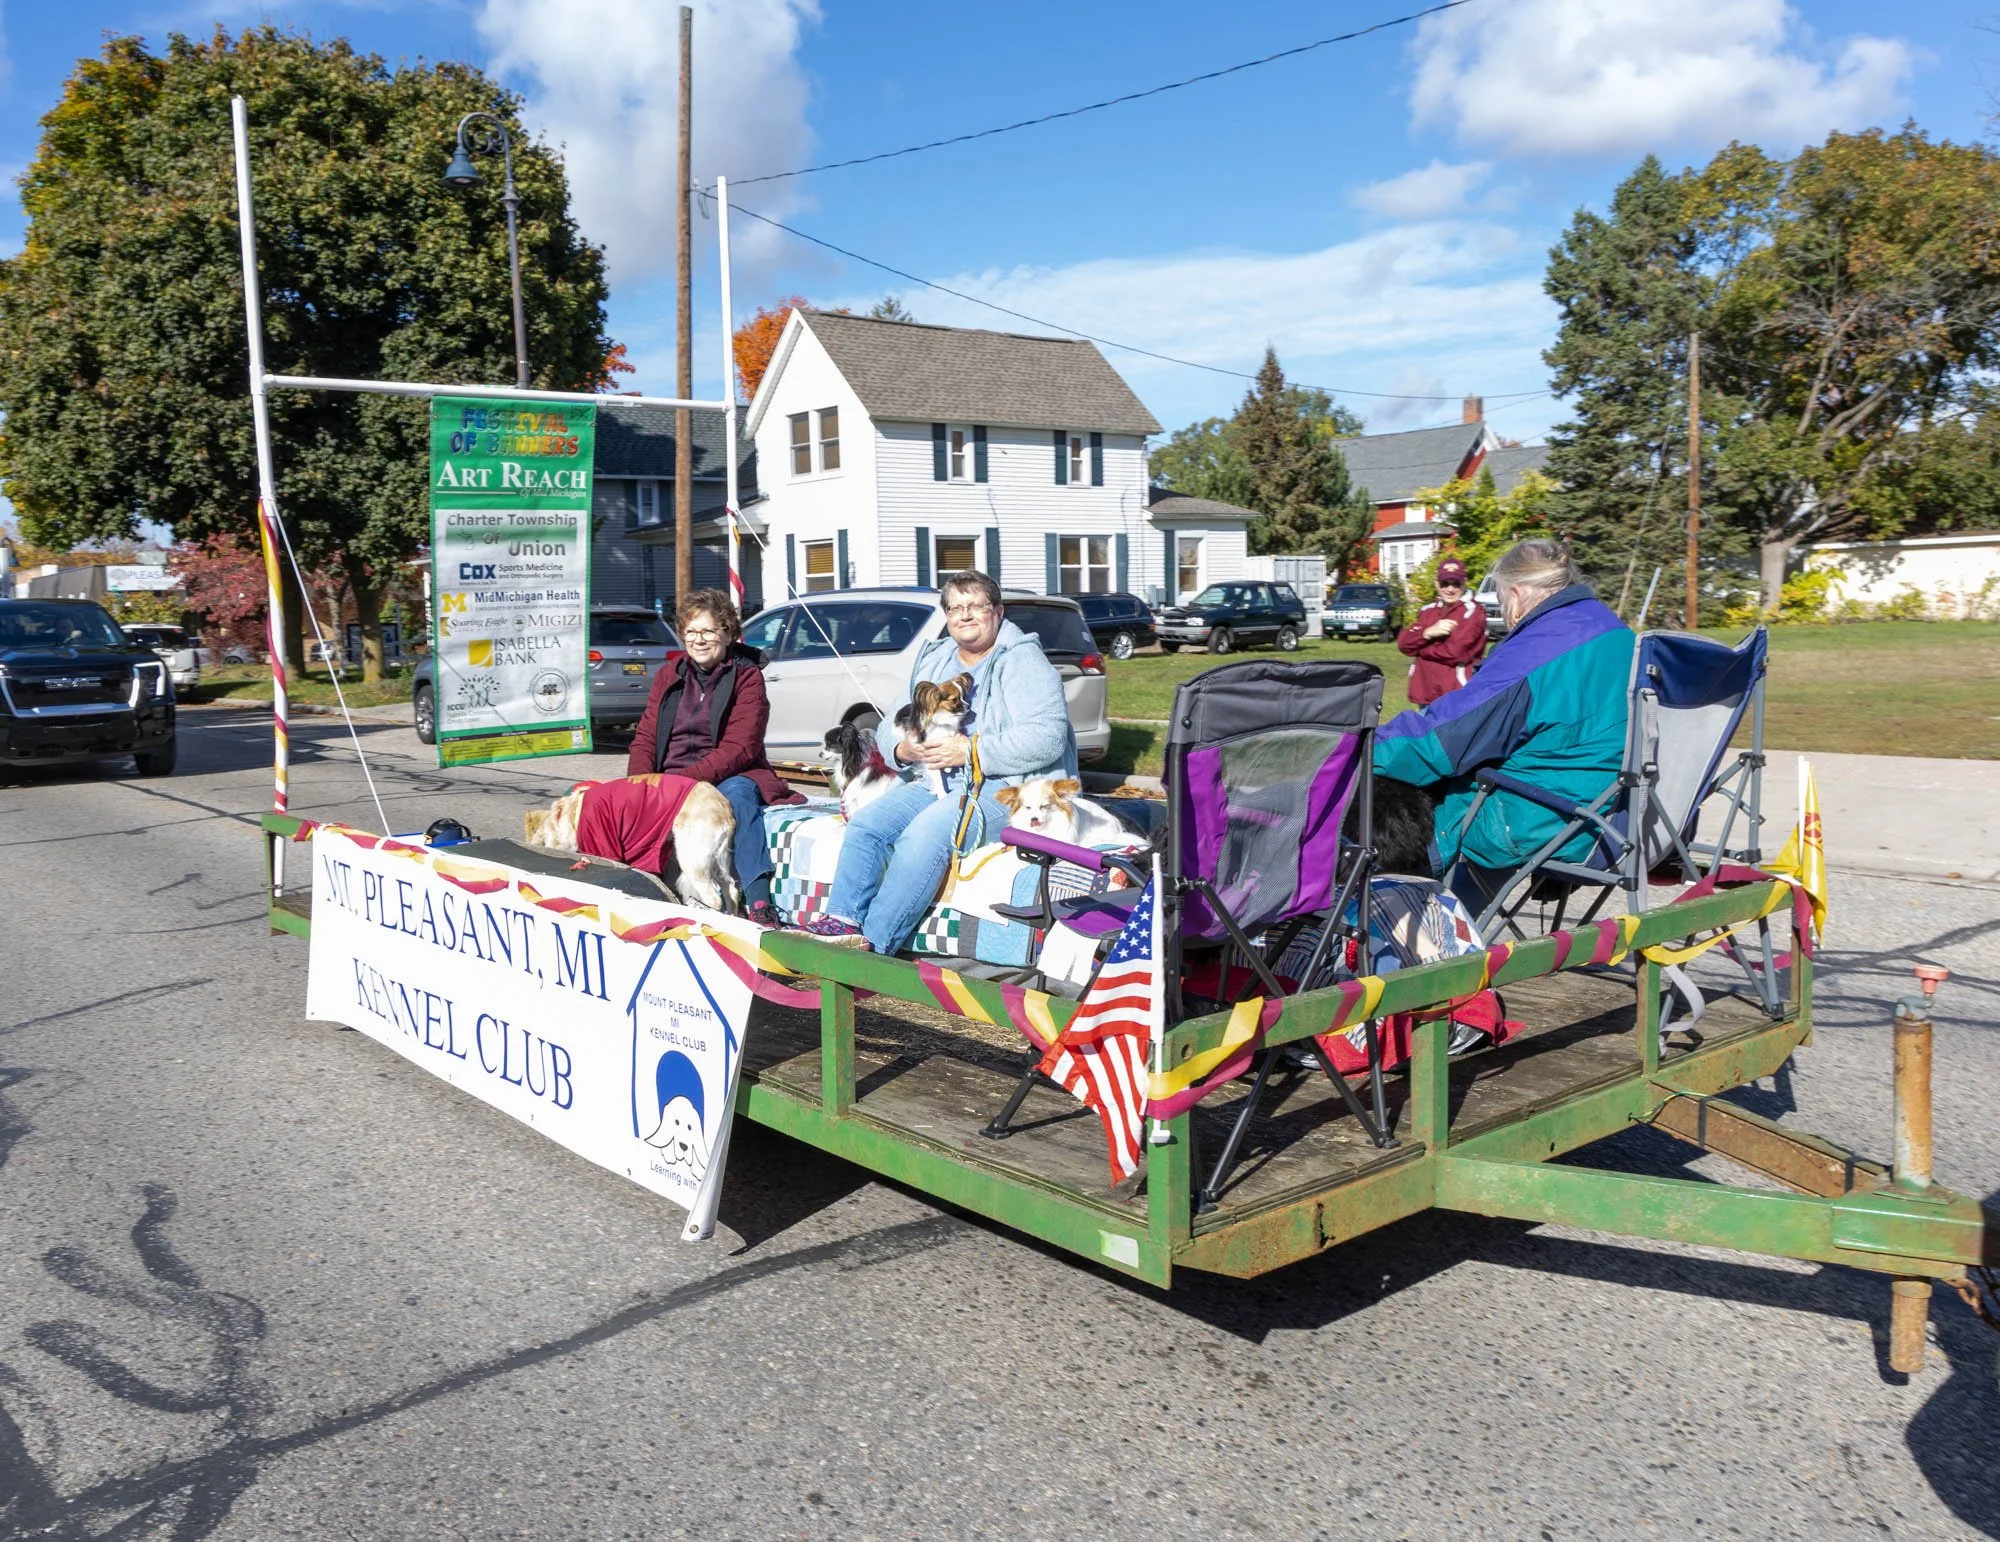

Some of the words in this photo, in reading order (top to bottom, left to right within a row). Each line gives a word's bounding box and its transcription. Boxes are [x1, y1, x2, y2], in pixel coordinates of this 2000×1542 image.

[461, 408, 569, 435] FESTIVAL
[450, 431, 478, 455] OF
[486, 432, 580, 457] BANNERS
[447, 513, 503, 526] Charter
[508, 514, 577, 528] Township
[508, 540, 566, 557] Union
[499, 564, 524, 572] Sports
[526, 563, 563, 571] Medicine
[441, 592, 467, 613] M
[475, 590, 543, 603] MidMichigan
[547, 589, 580, 600] Health
[494, 636, 561, 651] ISABELLA
[495, 651, 537, 666] BANK
[362, 869, 544, 990] PLEASANT,
[551, 922, 611, 1002] MI
[643, 992, 667, 1009] MOUNT
[669, 1000, 712, 1021] PLEASANT
[671, 1017, 680, 1028] MI
[352, 957, 468, 1060] KENNEL
[476, 1013, 573, 1110] CLUB
[649, 1027, 680, 1045] KENNEL
[682, 1036, 706, 1052] CLUB
[651, 1160, 681, 1186] Learning
